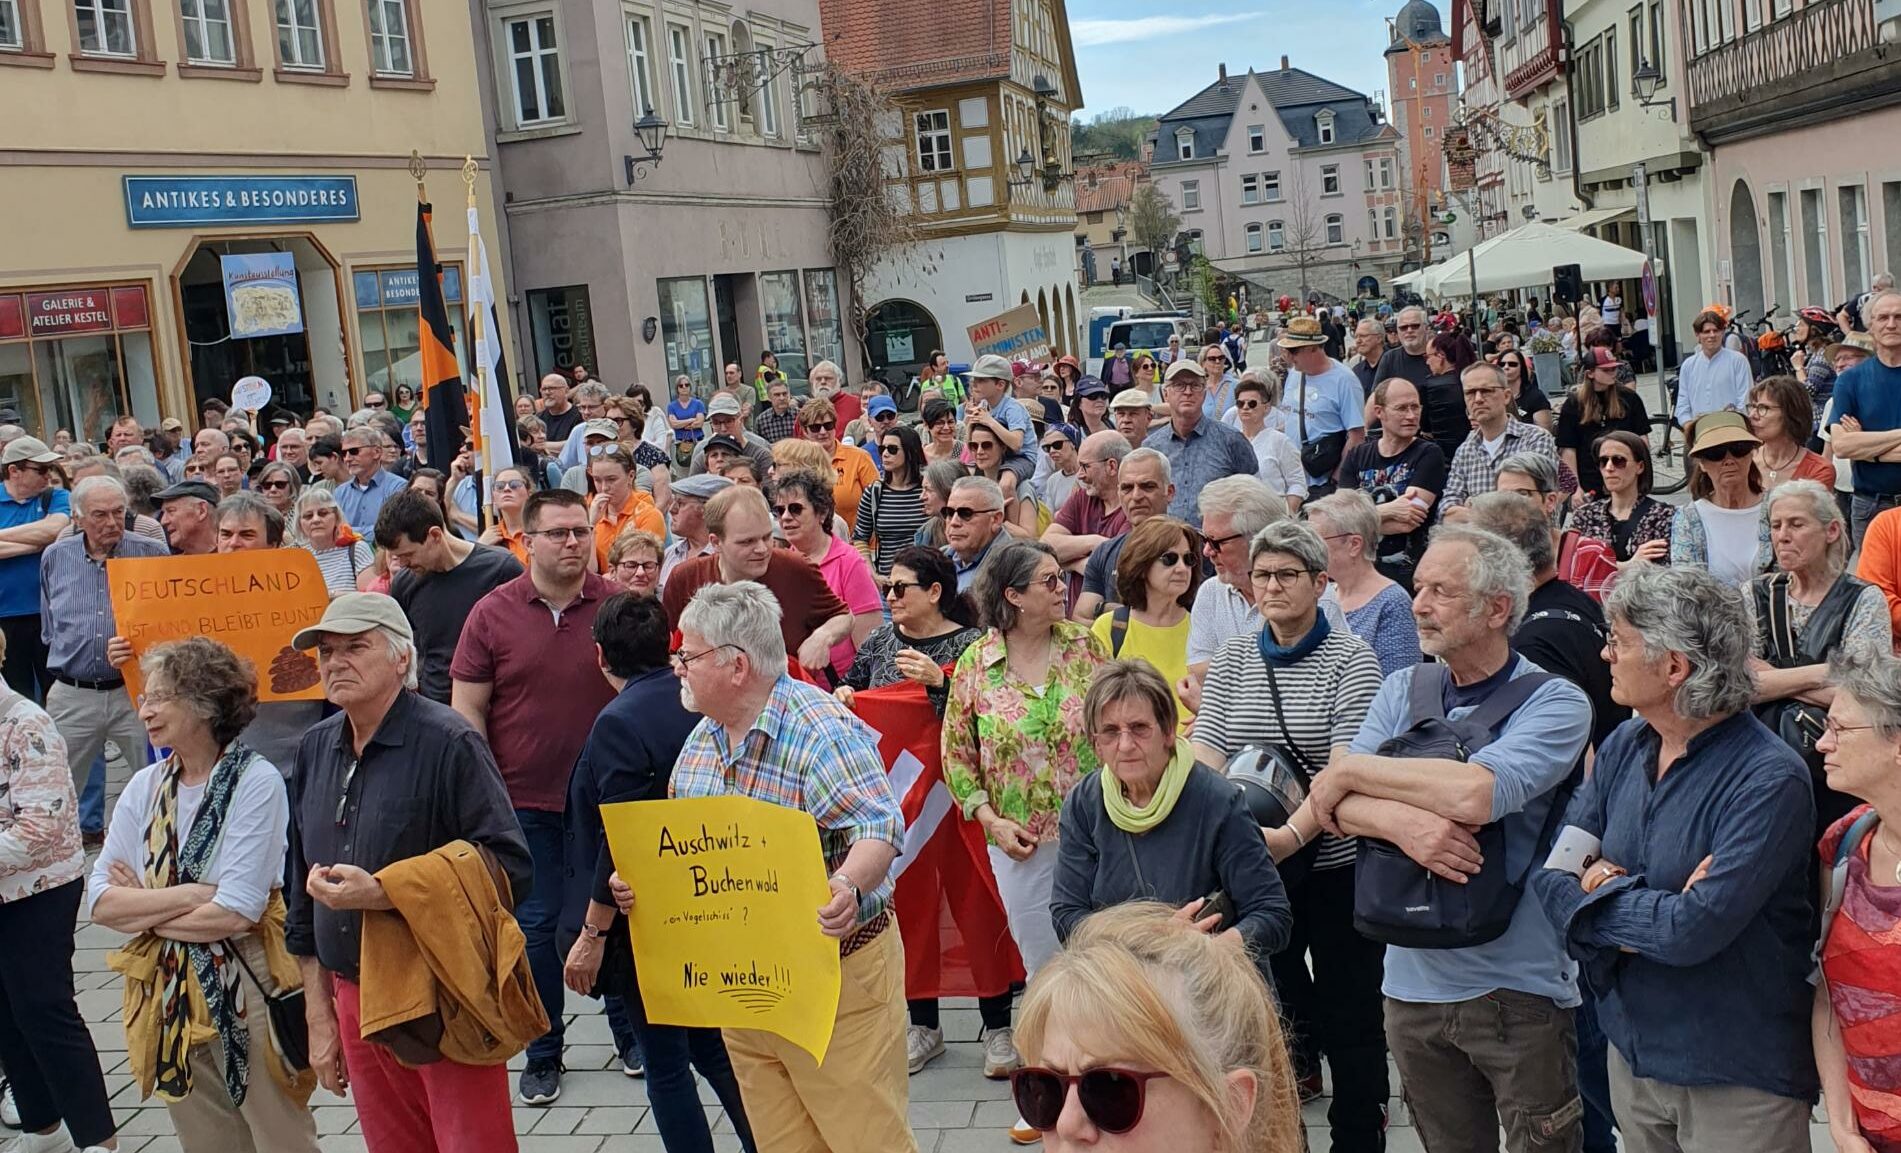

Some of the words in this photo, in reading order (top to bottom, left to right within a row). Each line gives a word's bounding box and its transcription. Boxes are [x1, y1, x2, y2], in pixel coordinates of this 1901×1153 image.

[143, 190, 221, 209] ANTIKES
[226, 190, 237, 208] &
[242, 189, 347, 207] BESONDERES
[229, 266, 295, 280] Kunstausstellung
[388, 275, 420, 286] ANTIKE
[42, 298, 84, 311] GALERIE
[86, 297, 95, 308] &
[386, 288, 420, 299] BESONDE
[33, 314, 73, 327] ATELIER
[74, 311, 109, 324] KESTEL
[547, 301, 575, 368] edat
[974, 320, 1009, 343] ANTI-
[977, 327, 1046, 356] FEMINISTEN
[125, 571, 301, 601] DEUTSCHLAND
[271, 605, 323, 627] BUNT
[658, 822, 751, 858] Auschwitz
[761, 835, 768, 848] +
[684, 961, 709, 989] Nie
